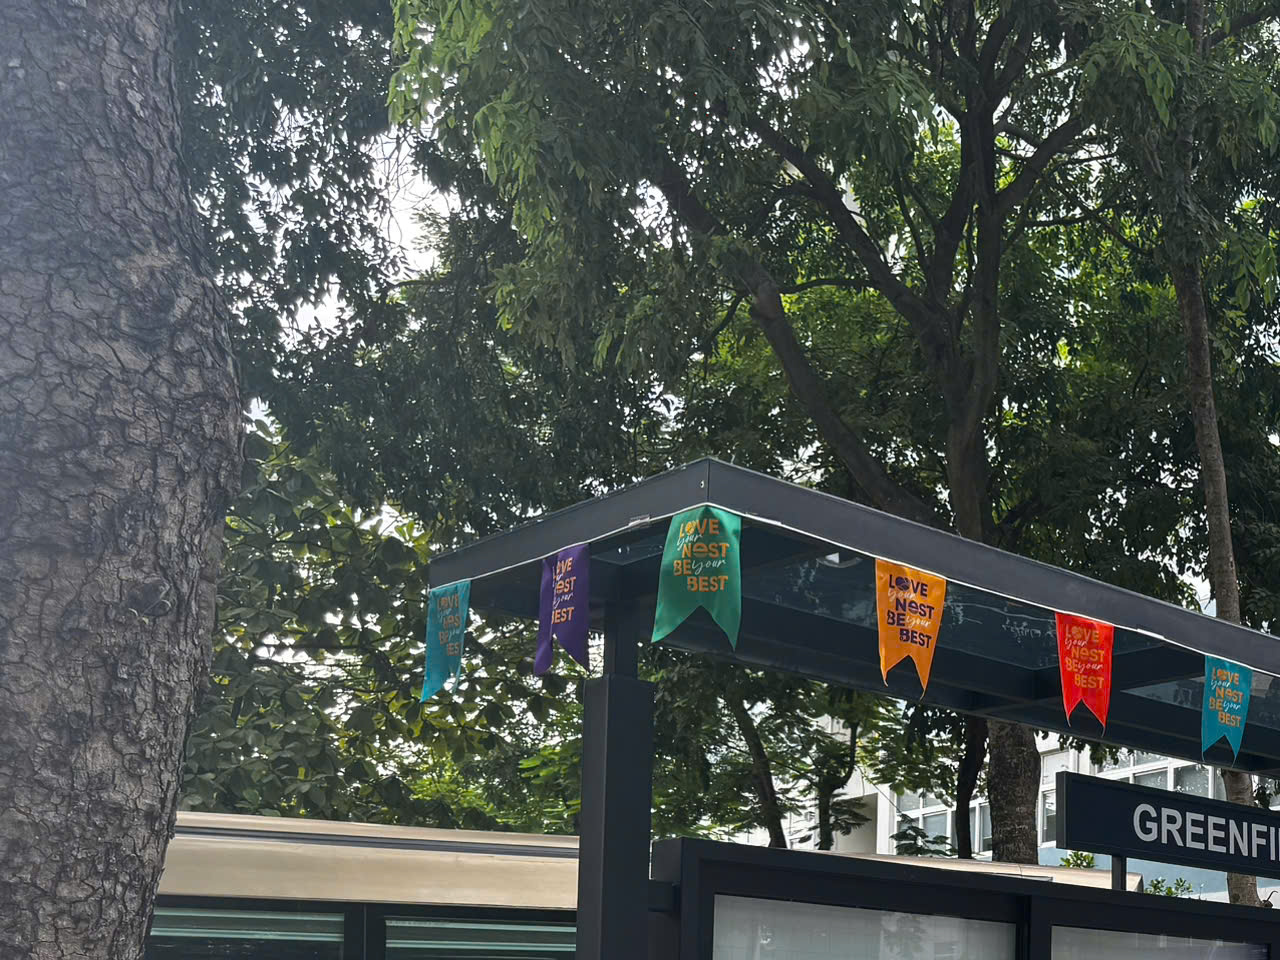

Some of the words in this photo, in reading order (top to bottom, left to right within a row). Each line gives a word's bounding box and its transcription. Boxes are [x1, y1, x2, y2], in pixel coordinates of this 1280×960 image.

[679, 518, 720, 538] LOVE
[673, 560, 692, 576] BE
[687, 575, 728, 592] BEST
[889, 574, 928, 597] LOVE
[552, 606, 575, 624] EST
[887, 610, 905, 626] BE
[899, 628, 932, 648] BEST
[1066, 624, 1099, 642] LOVE
[1065, 657, 1078, 672] BE
[1075, 673, 1104, 688] BEST
[1212, 667, 1240, 685] LOVE
[1209, 696, 1223, 711] BE
[1219, 711, 1241, 727] BEST
